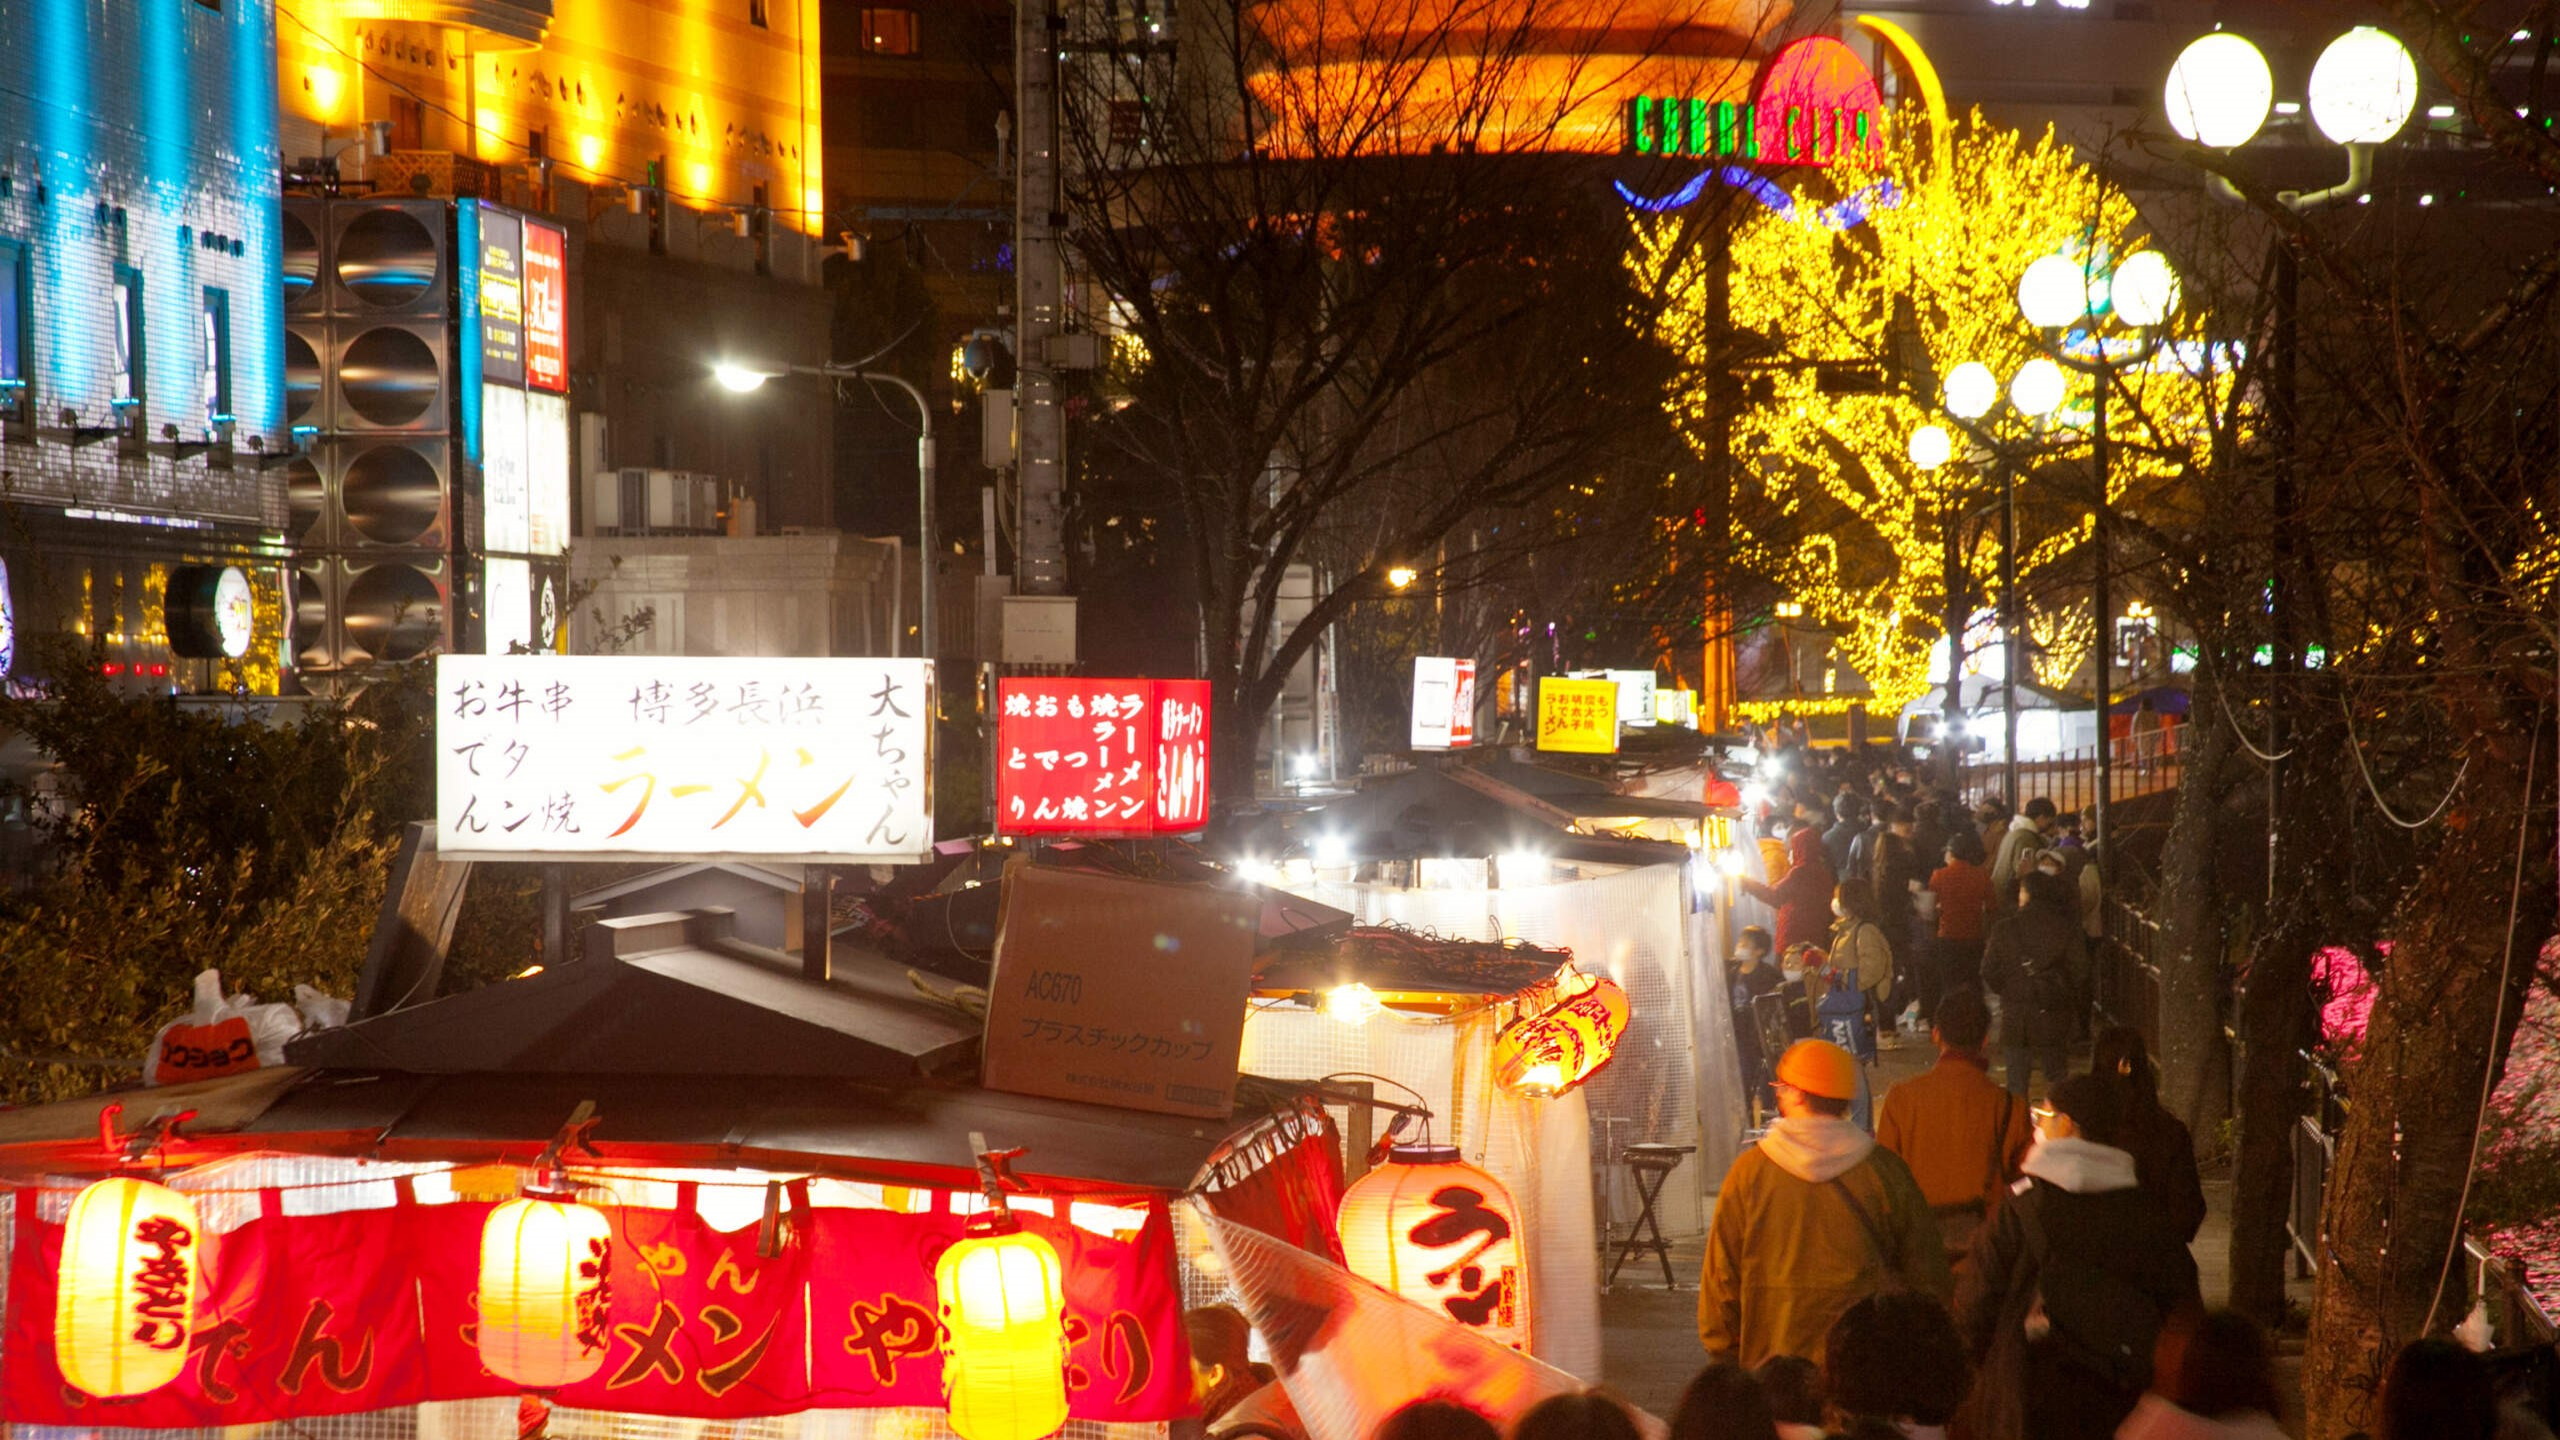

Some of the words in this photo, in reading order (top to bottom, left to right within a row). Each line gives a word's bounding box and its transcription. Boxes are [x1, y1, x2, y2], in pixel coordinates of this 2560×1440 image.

[1635, 94, 1760, 158] CANAL
[1786, 104, 1869, 162] CITY
[453, 680, 490, 834] おでん
[497, 678, 533, 834] 牛タン
[540, 680, 581, 834] 串焼
[629, 680, 825, 727] 博多長浜
[866, 674, 912, 846] 大ちゃん
[1005, 693, 1031, 819] 焼とり
[1033, 694, 1059, 819] おでん
[1062, 694, 1089, 821] もつ焼
[1090, 693, 1119, 817] 焼ラーメン
[1119, 693, 1145, 819] ラーメン
[599, 745, 856, 839] ラーメン
[1021, 1017, 1215, 1062] プラスチックカップ
[1024, 970, 1082, 1004] AC670
[844, 1293, 1154, 1403] やり
